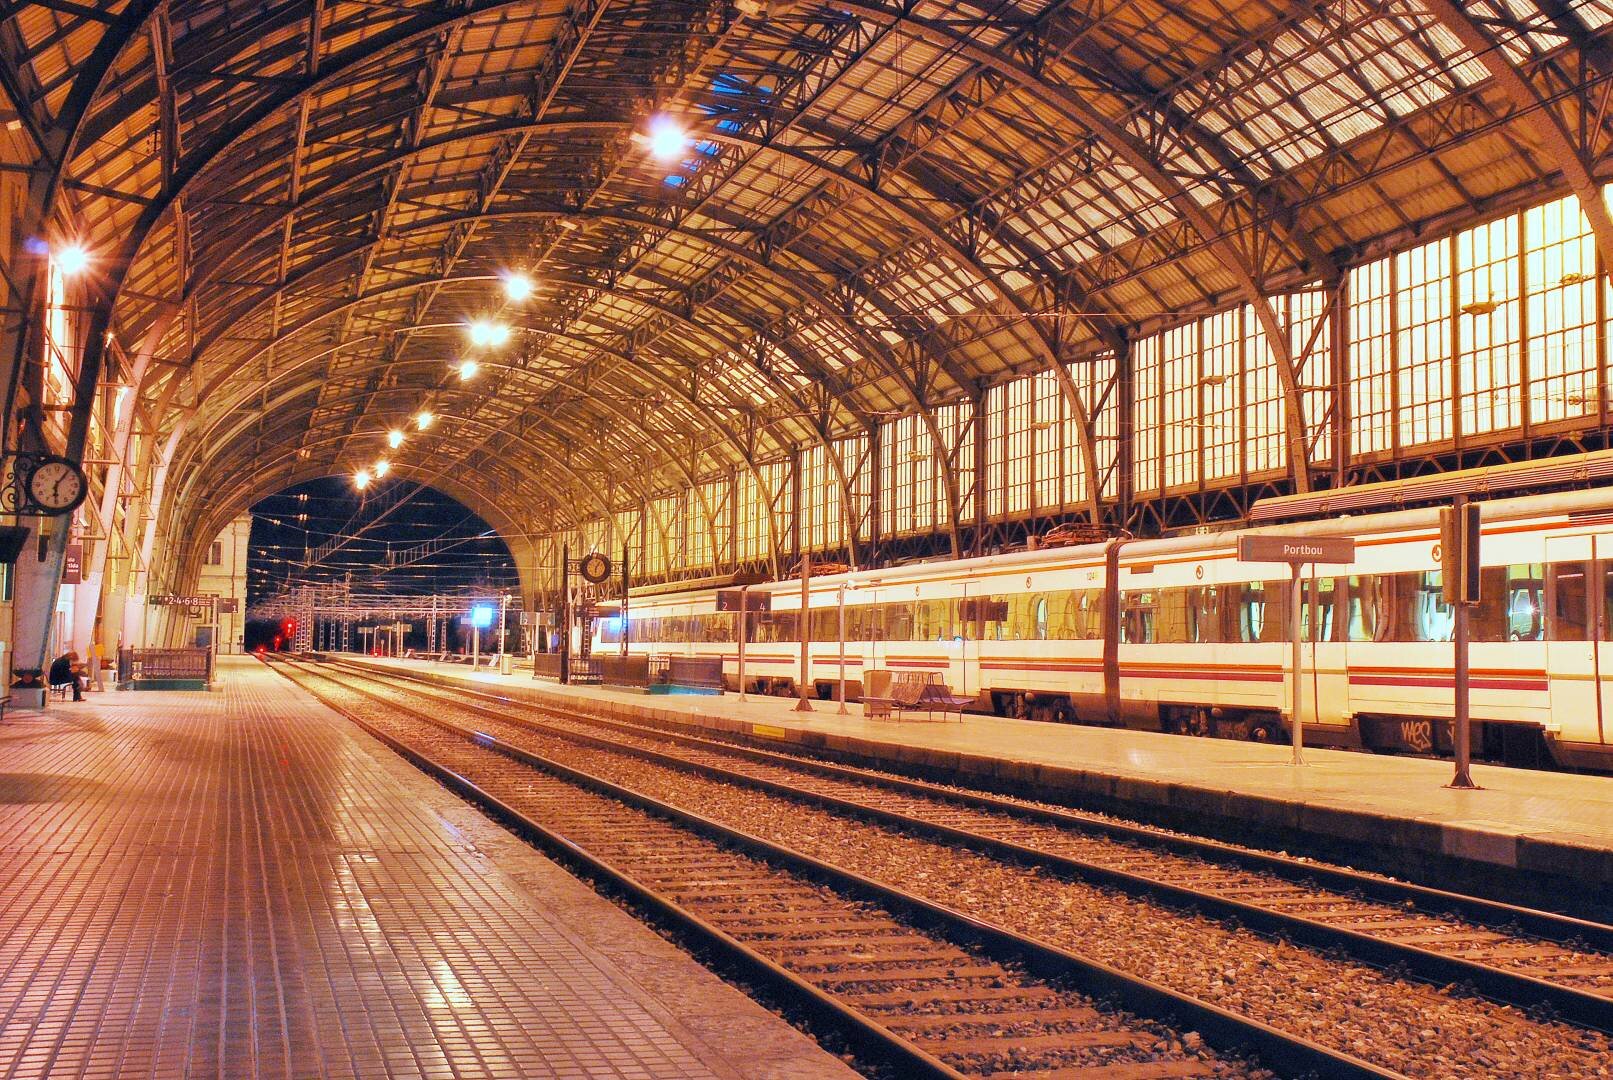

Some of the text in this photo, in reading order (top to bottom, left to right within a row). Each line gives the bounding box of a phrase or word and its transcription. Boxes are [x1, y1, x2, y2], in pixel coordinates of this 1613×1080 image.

[1283, 544, 1323, 555] Portbou
[232, 605, 237, 613] 1
[722, 602, 728, 611] 2
[760, 602, 766, 612] 4
